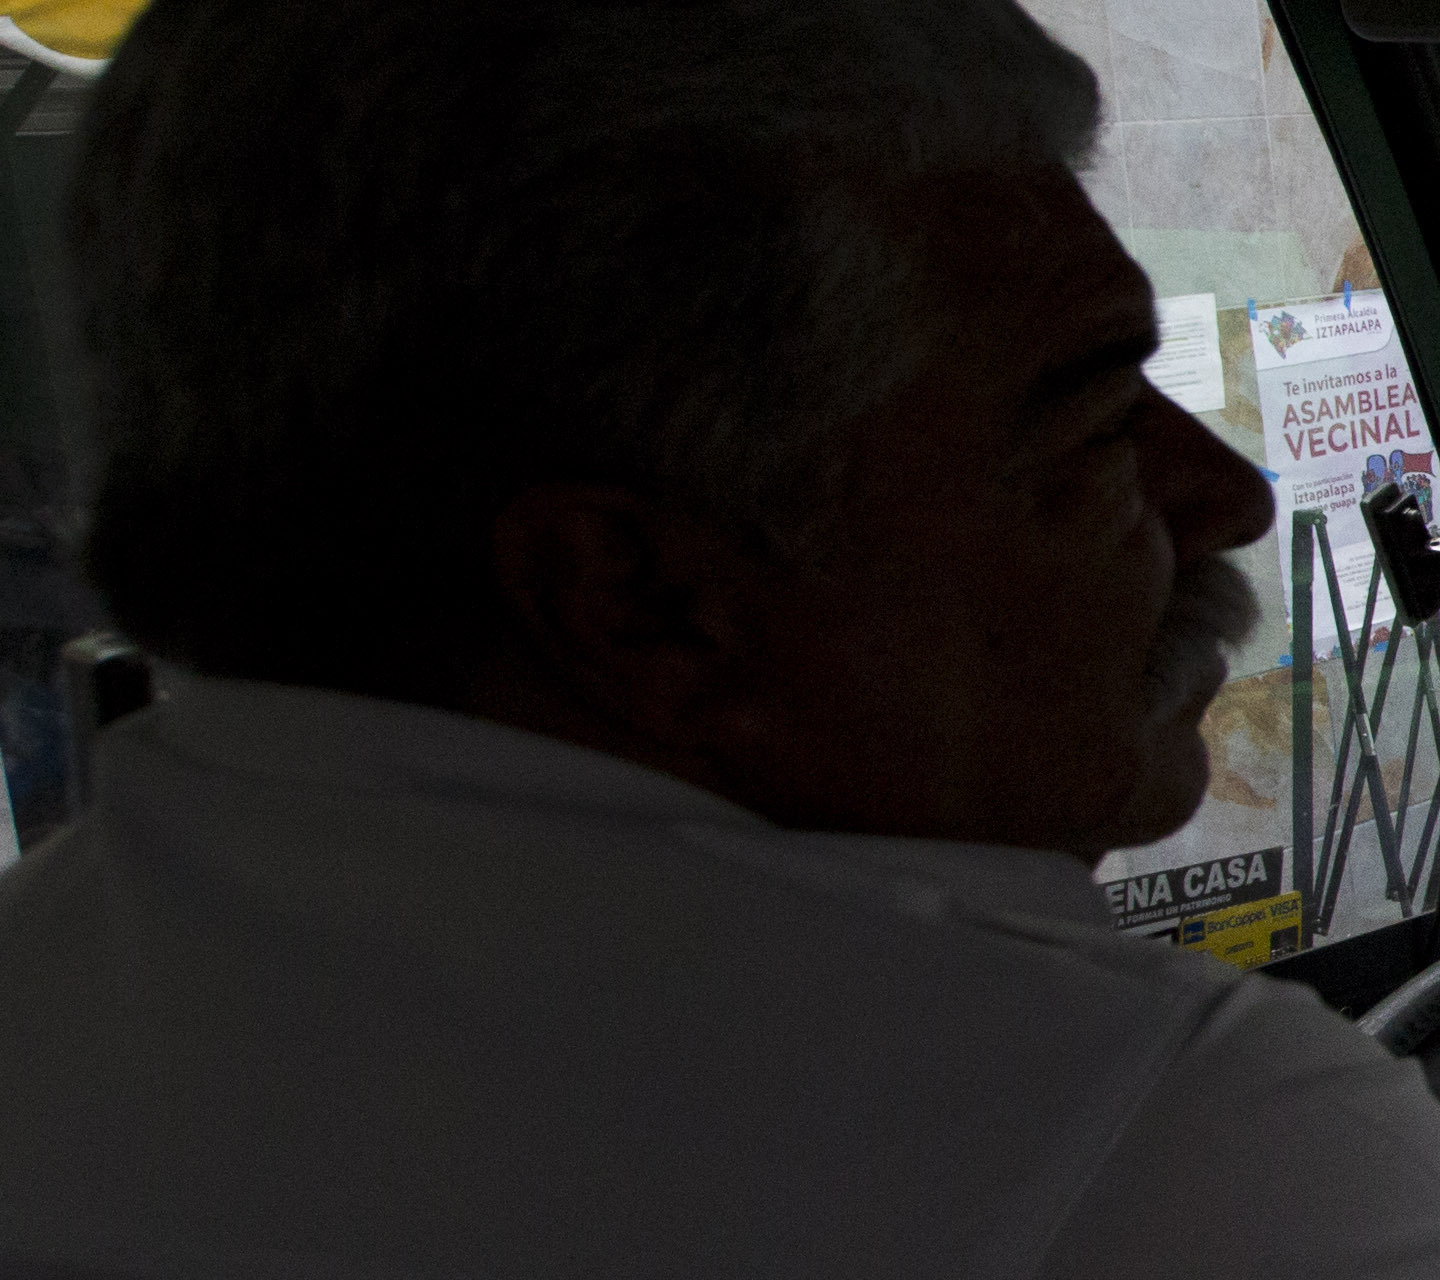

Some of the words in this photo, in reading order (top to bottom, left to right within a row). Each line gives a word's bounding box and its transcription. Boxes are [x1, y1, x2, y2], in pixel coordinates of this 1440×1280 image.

[1316, 319, 1382, 339] IZTAPALAPA
[1284, 381, 1300, 397] Te
[1303, 371, 1372, 394] invitamos
[1374, 370, 1383, 381] a
[1386, 363, 1398, 379] la
[1283, 382, 1417, 428] ASAMBLEA
[1284, 410, 1420, 461] VECINAL
[1294, 483, 1355, 504] Iztapalapa
[1330, 497, 1356, 512] guapa
[1104, 874, 1174, 915] ENA
[1184, 853, 1268, 898] CASA
[1270, 899, 1299, 916] VISA
